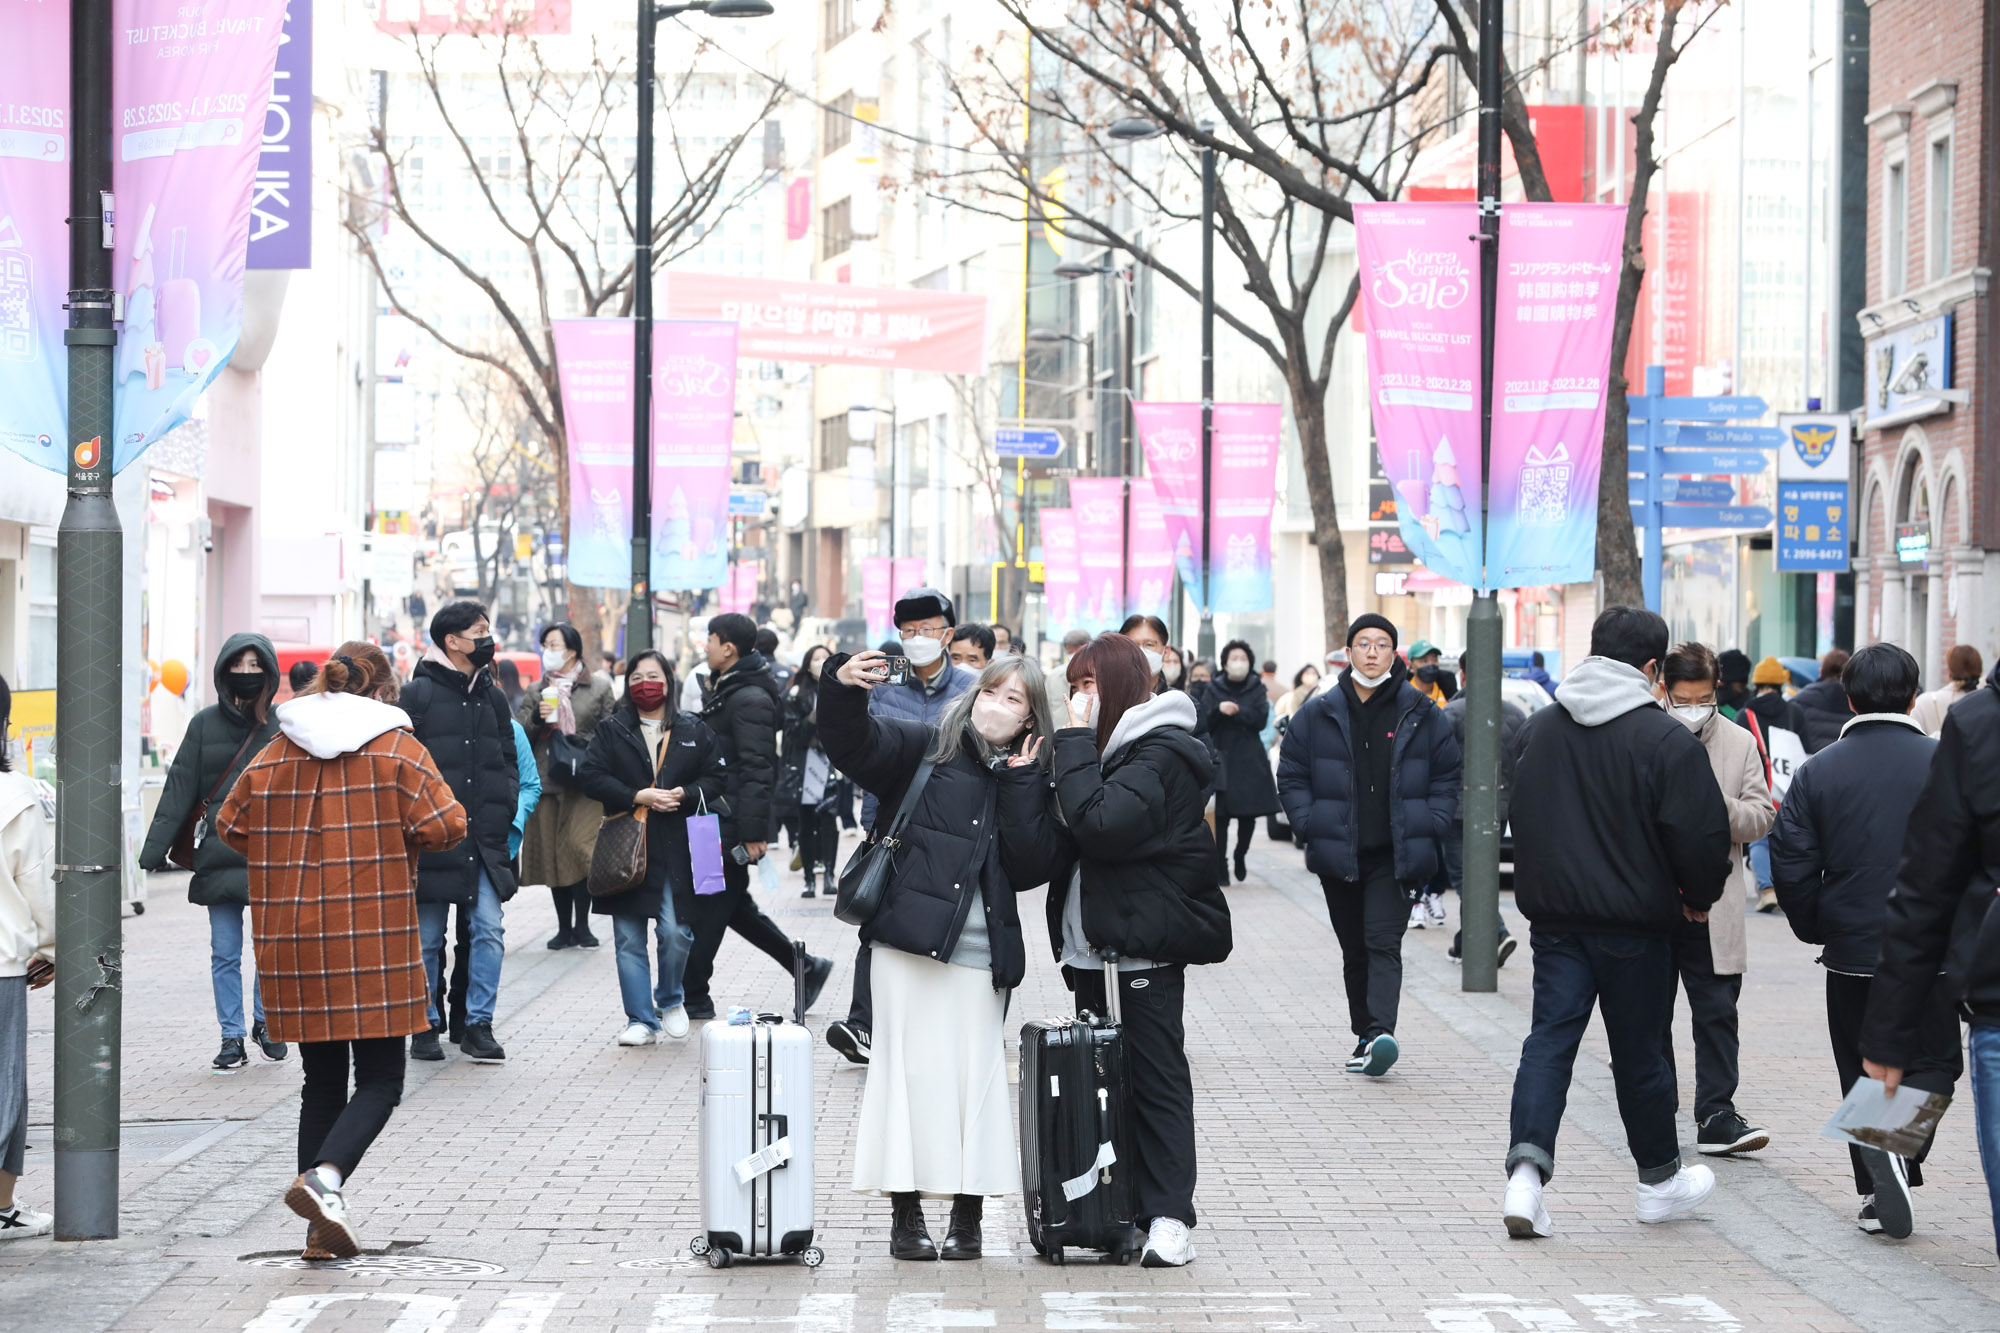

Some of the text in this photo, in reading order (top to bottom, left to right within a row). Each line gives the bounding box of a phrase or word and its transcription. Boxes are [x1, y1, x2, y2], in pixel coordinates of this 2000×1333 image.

[1406, 247, 1457, 265] Korea
[1410, 259, 1465, 277] Grand
[1372, 264, 1469, 309] Sale
[1376, 329, 1472, 345] TRAVEL BUCKET LIST
[1707, 401, 1738, 414] Sydney
[1726, 430, 1754, 442] Paulo
[1712, 456, 1738, 469] Taipei
[75, 472, 100, 481] 서울중구
[1718, 511, 1744, 523] Tokyo
